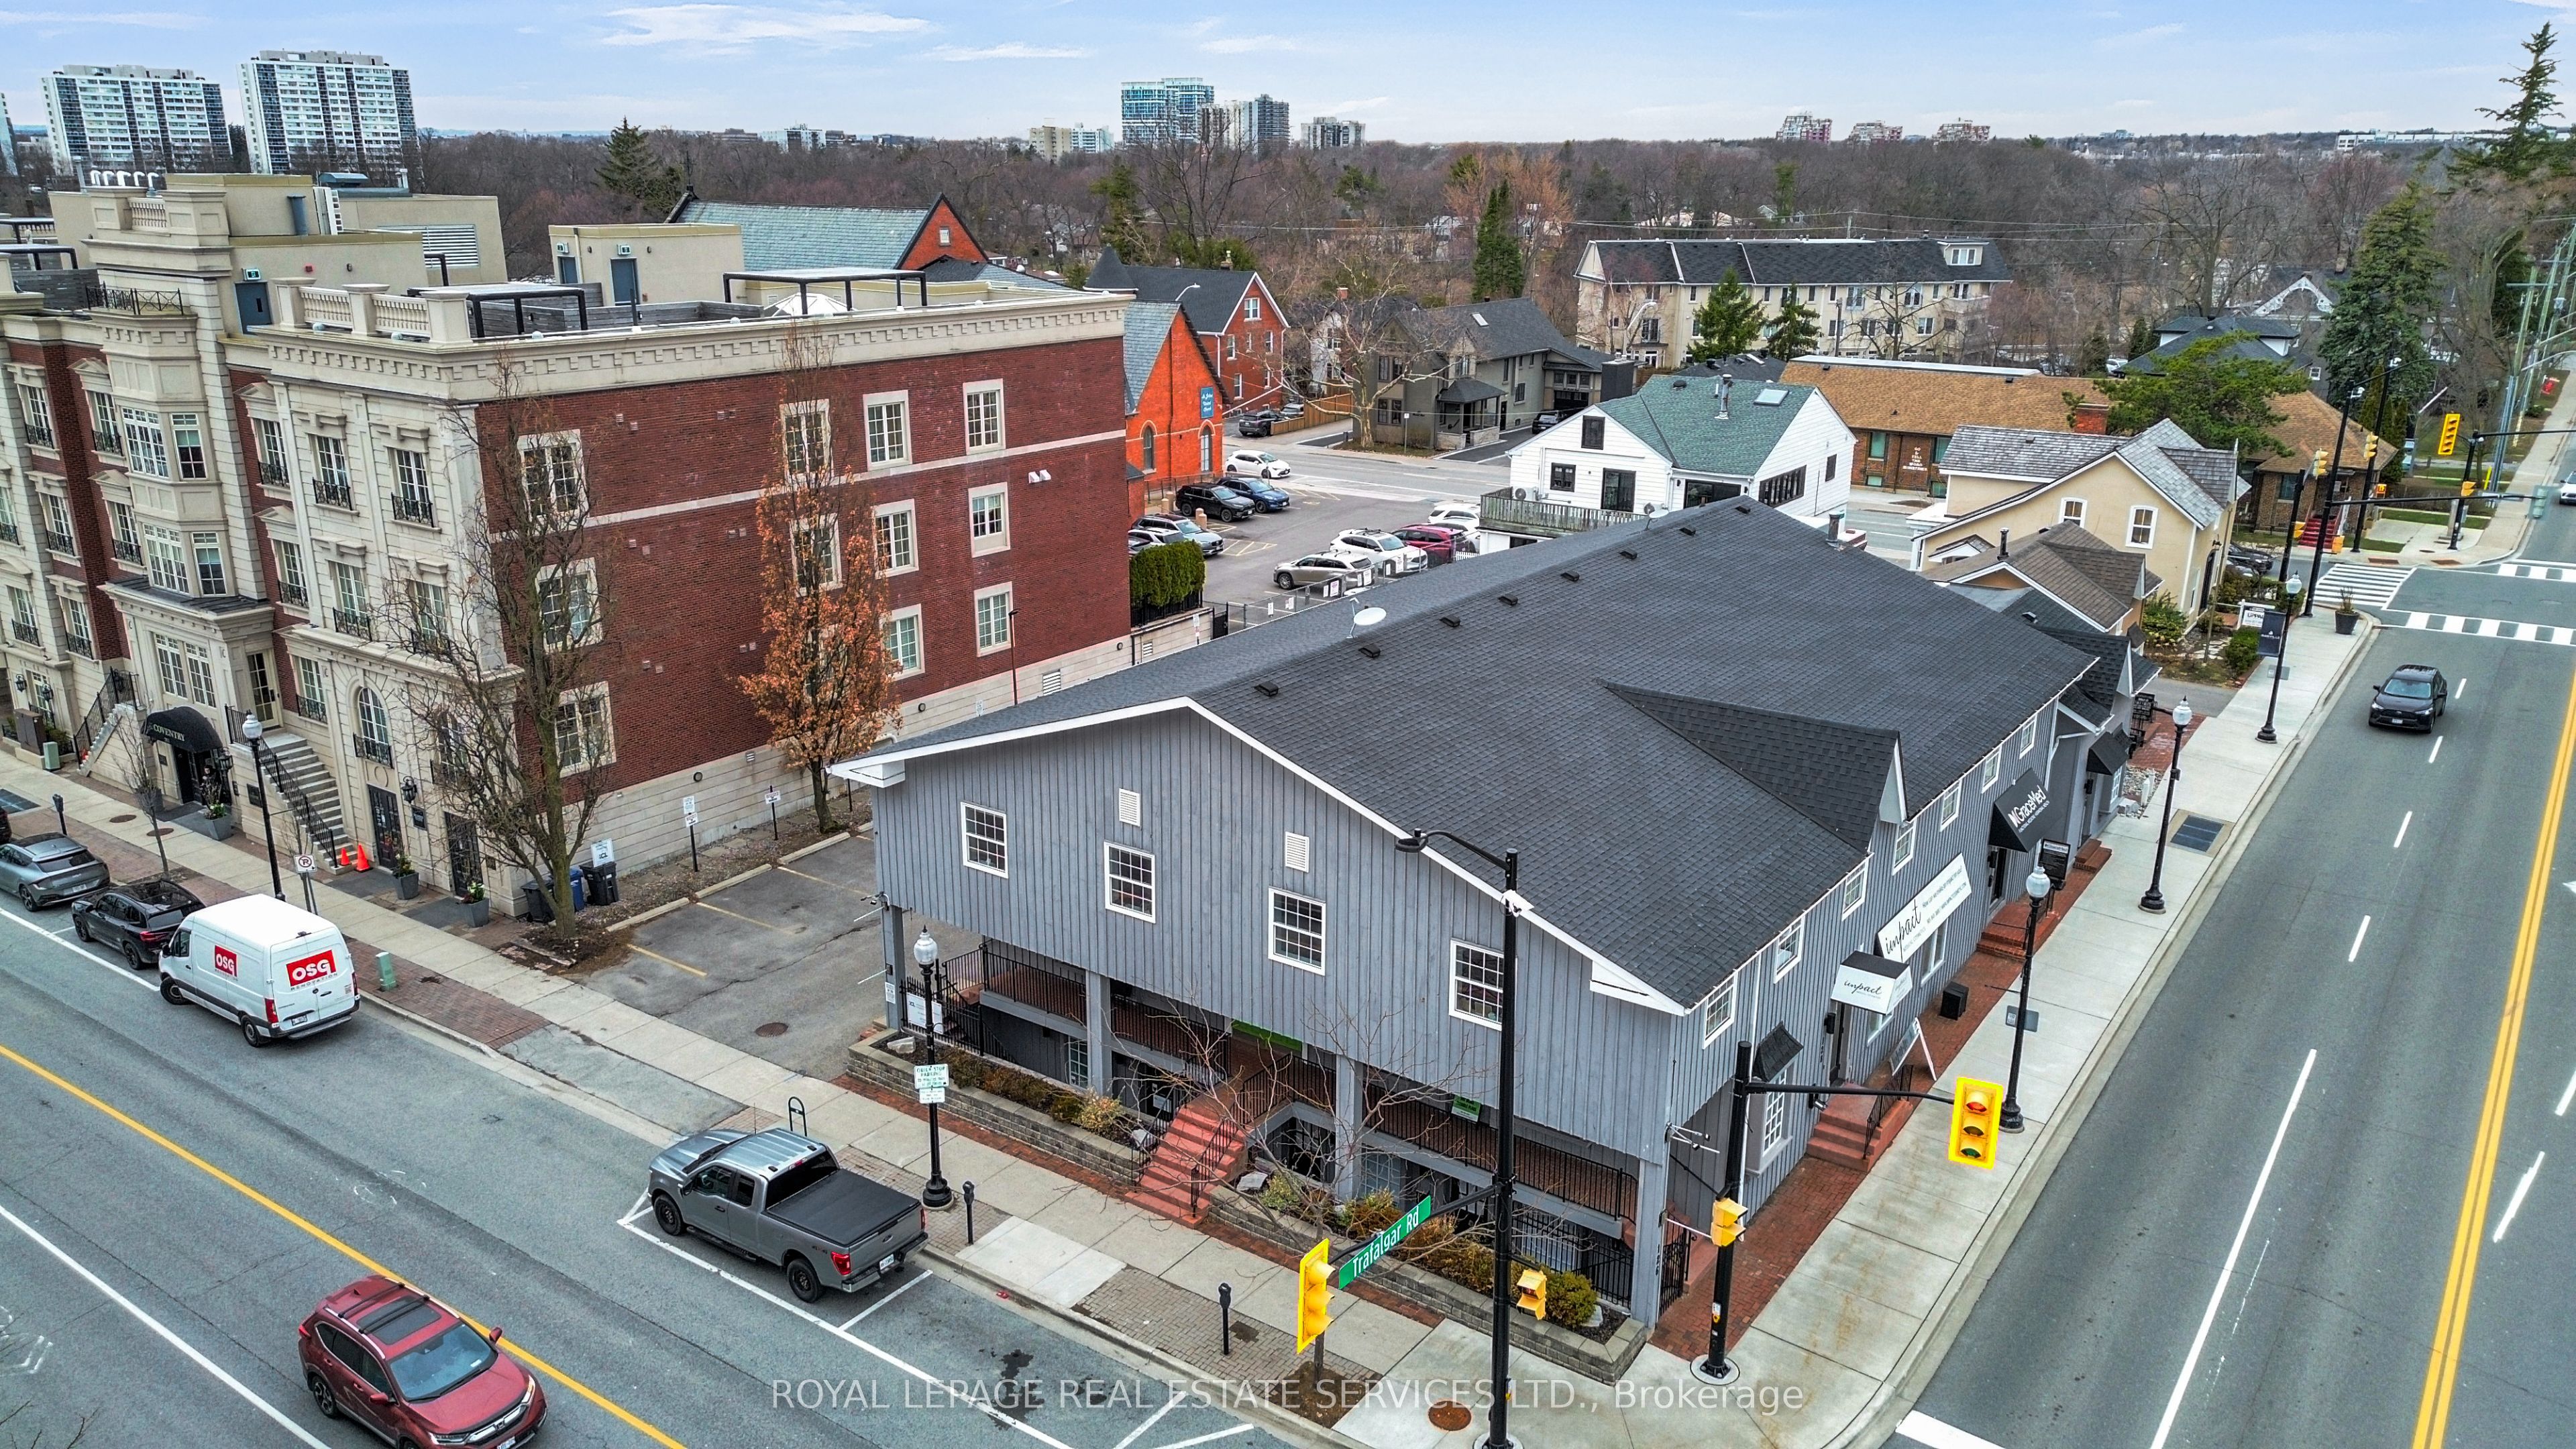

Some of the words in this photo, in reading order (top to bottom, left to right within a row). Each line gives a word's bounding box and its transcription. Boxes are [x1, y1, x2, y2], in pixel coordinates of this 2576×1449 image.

[153, 724, 185, 741] COVENTRY
[2014, 784, 2047, 822] GraceMed
[1886, 899, 1921, 963] impact
[216, 953, 235, 977] OSG
[292, 959, 331, 981] OSG
[290, 973, 337, 991] RENOVATION
[1844, 980, 1882, 994] impact
[1353, 1224, 1401, 1277] Trafalgar
[1407, 1205, 1419, 1234] Rd
